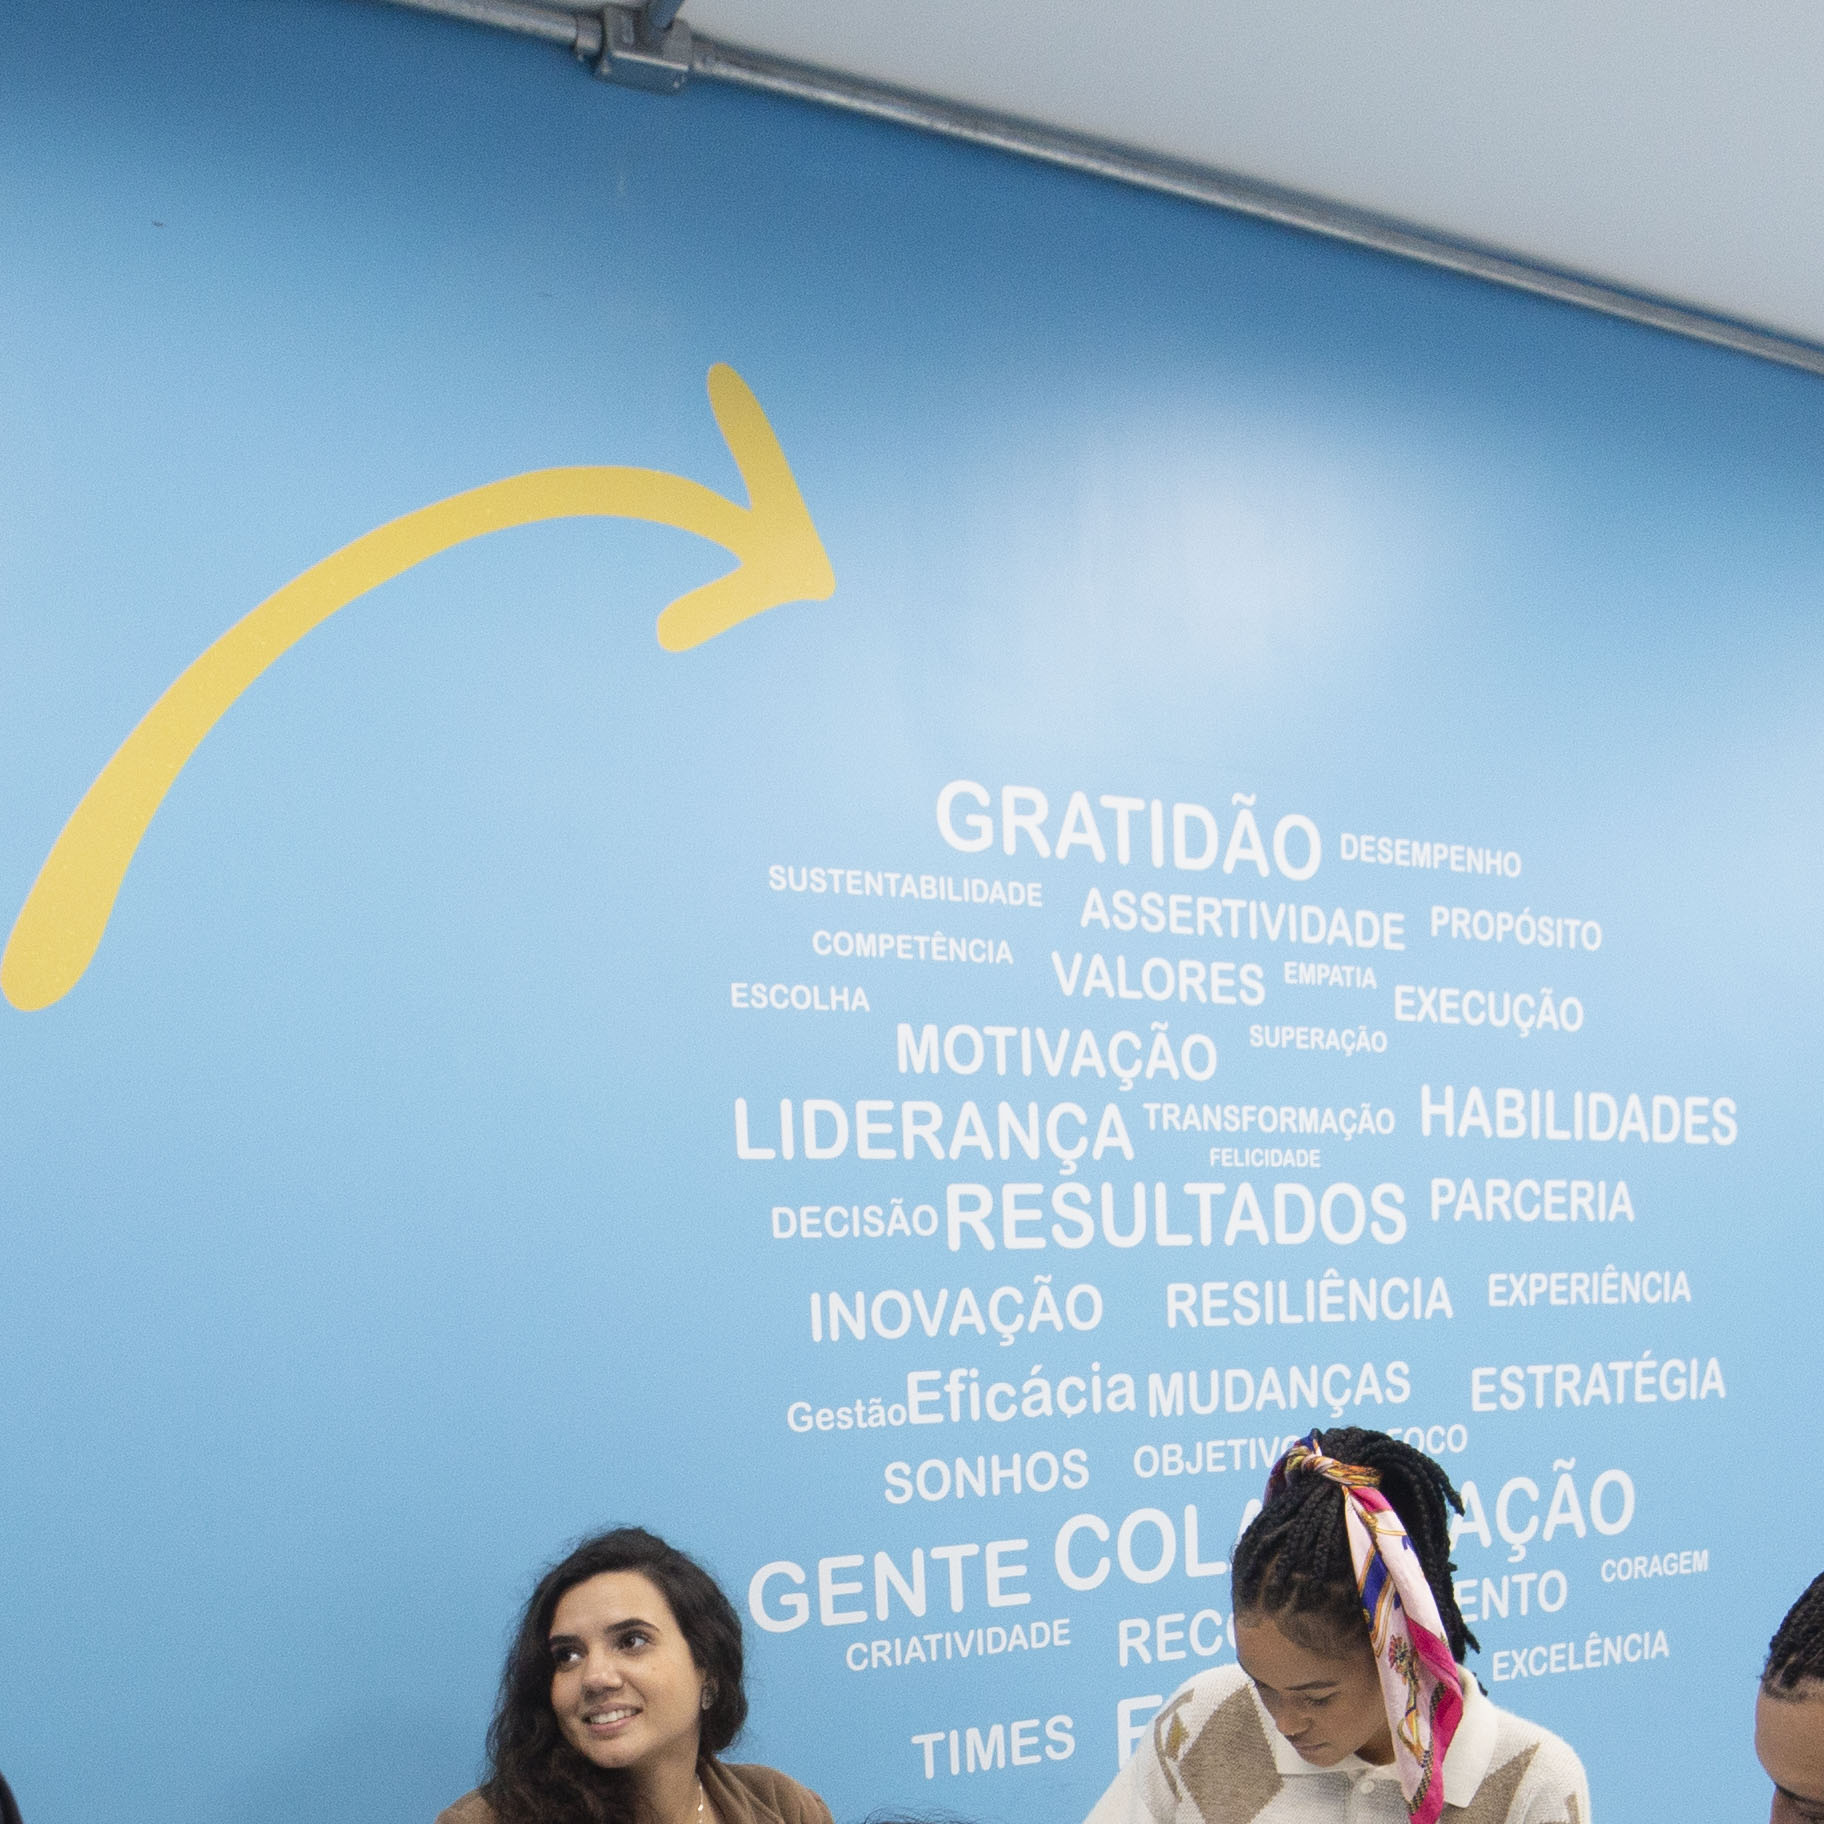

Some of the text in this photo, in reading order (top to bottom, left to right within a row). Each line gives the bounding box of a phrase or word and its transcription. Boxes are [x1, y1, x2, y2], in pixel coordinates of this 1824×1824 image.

[936, 780, 1322, 881] GRATIDÃO
[1340, 832, 1522, 878] DESEMPENHO
[768, 864, 1042, 907] SUSTENTABILIDADE
[1080, 887, 1406, 951] ASSERTIVIDADE
[1431, 905, 1603, 951] PROPÓSITO
[812, 929, 1013, 964] COMPETÊNCIA
[730, 982, 870, 1012] ESCOLHA
[1051, 951, 1266, 1006] VALORES
[1284, 961, 1377, 988] EMPATIA
[1394, 984, 1584, 1038] EXECUÇÃO
[896, 1021, 1218, 1091] MOTIVAÇÃO
[1249, 1024, 1388, 1056] SUPERAÇÃO
[734, 1097, 1135, 1175] LIDERANÇA
[1143, 1102, 1396, 1141] TRANSFORMAÇÃO
[1420, 1084, 1738, 1146] HABILIDADES
[1210, 1147, 1320, 1167] FELICIDADE
[771, 1197, 939, 1239] DECISÃO
[946, 1181, 1407, 1252] RESULTADOS
[1430, 1177, 1635, 1222] PARCERIA
[809, 1274, 1104, 1347] INOVAÇÃO
[1166, 1268, 1454, 1329] RESILIÊNCIA
[1488, 1263, 1692, 1307] EXPERIÊNCIA
[906, 1361, 1137, 1425] Eficácia
[1147, 1360, 1411, 1419] MUDANÇAS
[1470, 1349, 1727, 1413] ESTRATÉGIA
[786, 1397, 908, 1433] Gestão
[1386, 1423, 1469, 1456] OCO
[884, 1448, 1090, 1505] SONHOS
[747, 1538, 1032, 1634] GENTE
[1600, 1549, 1710, 1583] CORAGEM
[845, 1618, 1071, 1672] CRIATIVIDADE
[1492, 1629, 1670, 1681] EXCELÊNCIA
[910, 1714, 1076, 1780] TIMES
